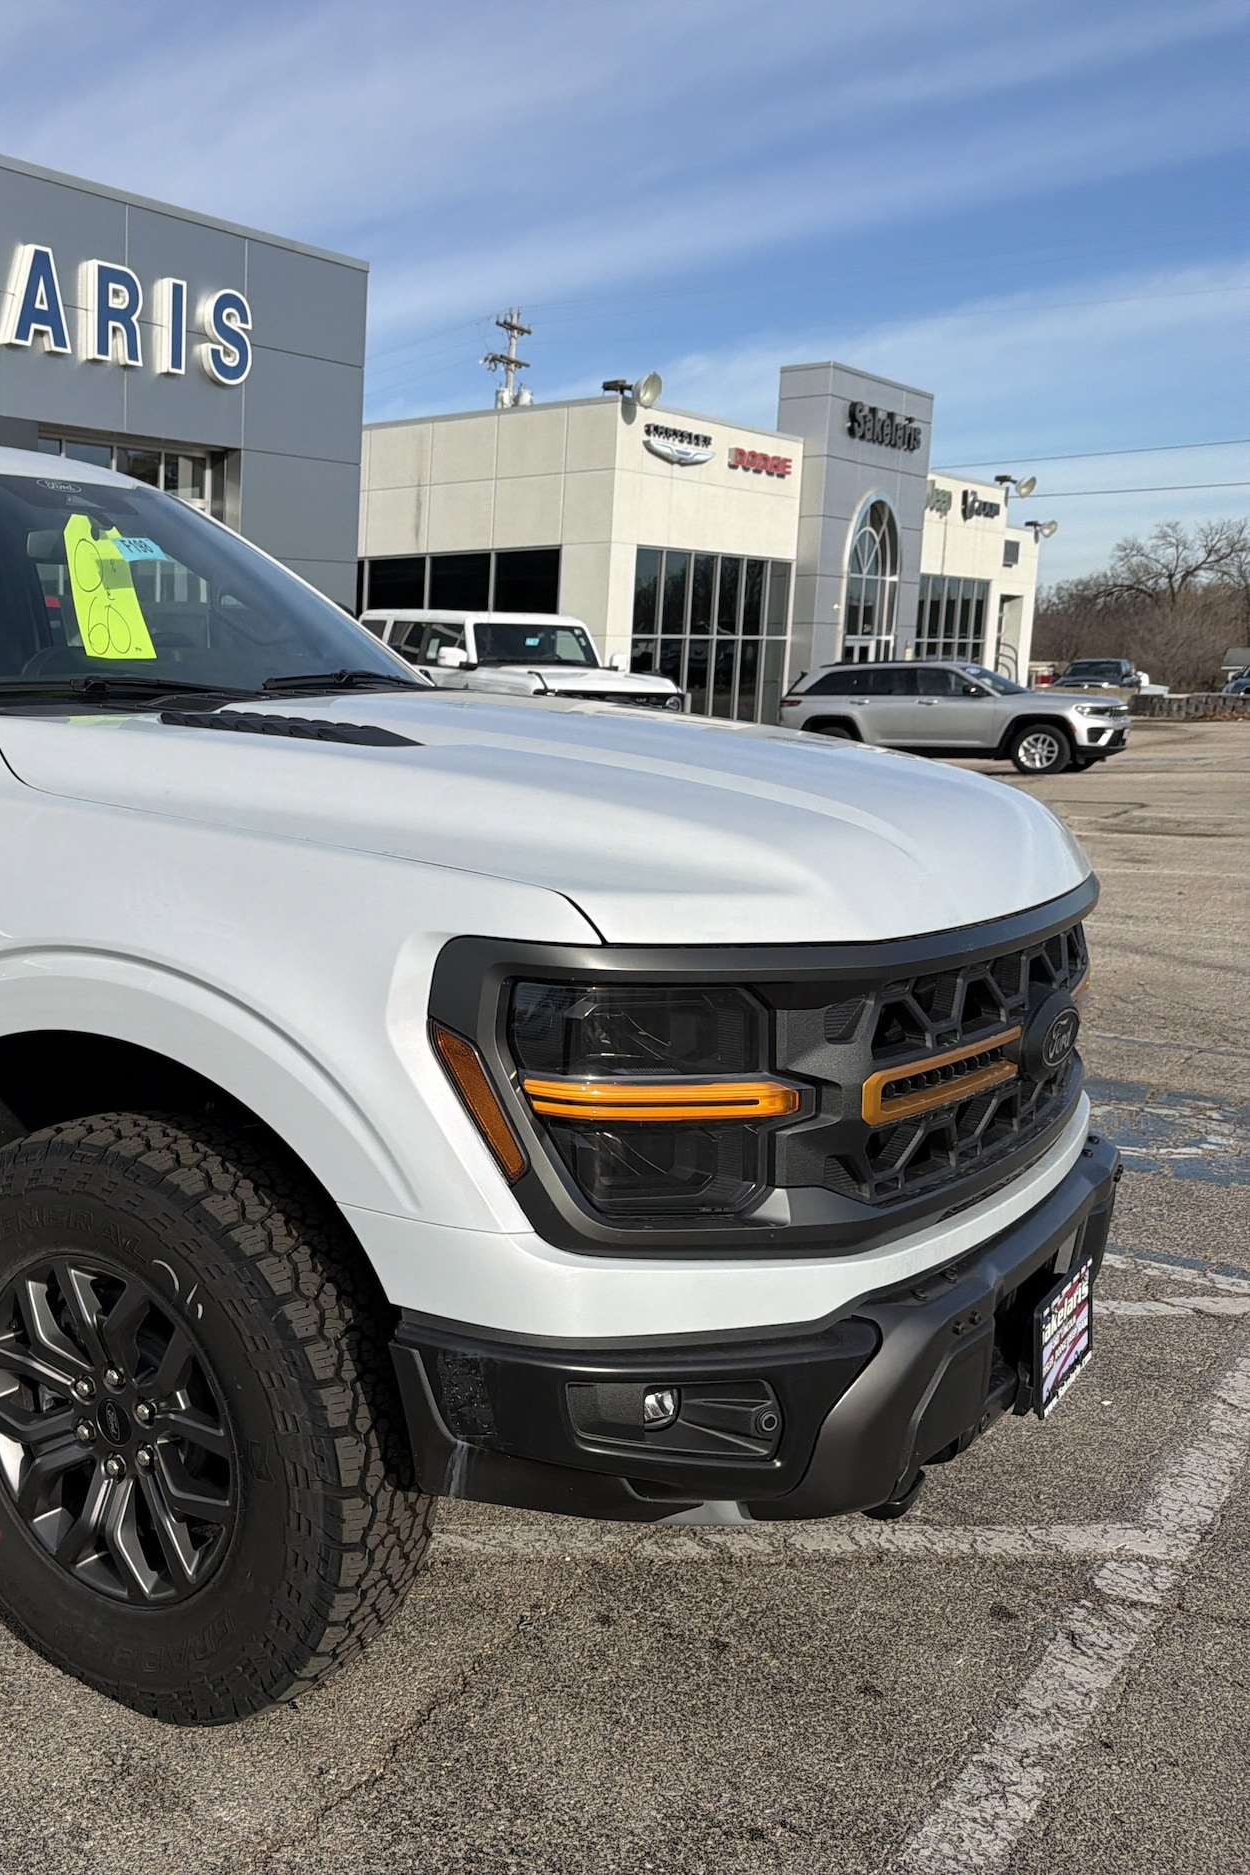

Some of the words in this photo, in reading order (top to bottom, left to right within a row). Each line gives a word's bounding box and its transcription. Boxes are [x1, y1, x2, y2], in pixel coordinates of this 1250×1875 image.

[848, 401, 921, 451] Sakelaris
[728, 447, 792, 478] DODGE
[120, 539, 154, 553] F198
[1049, 1018, 1073, 1059] Ford
